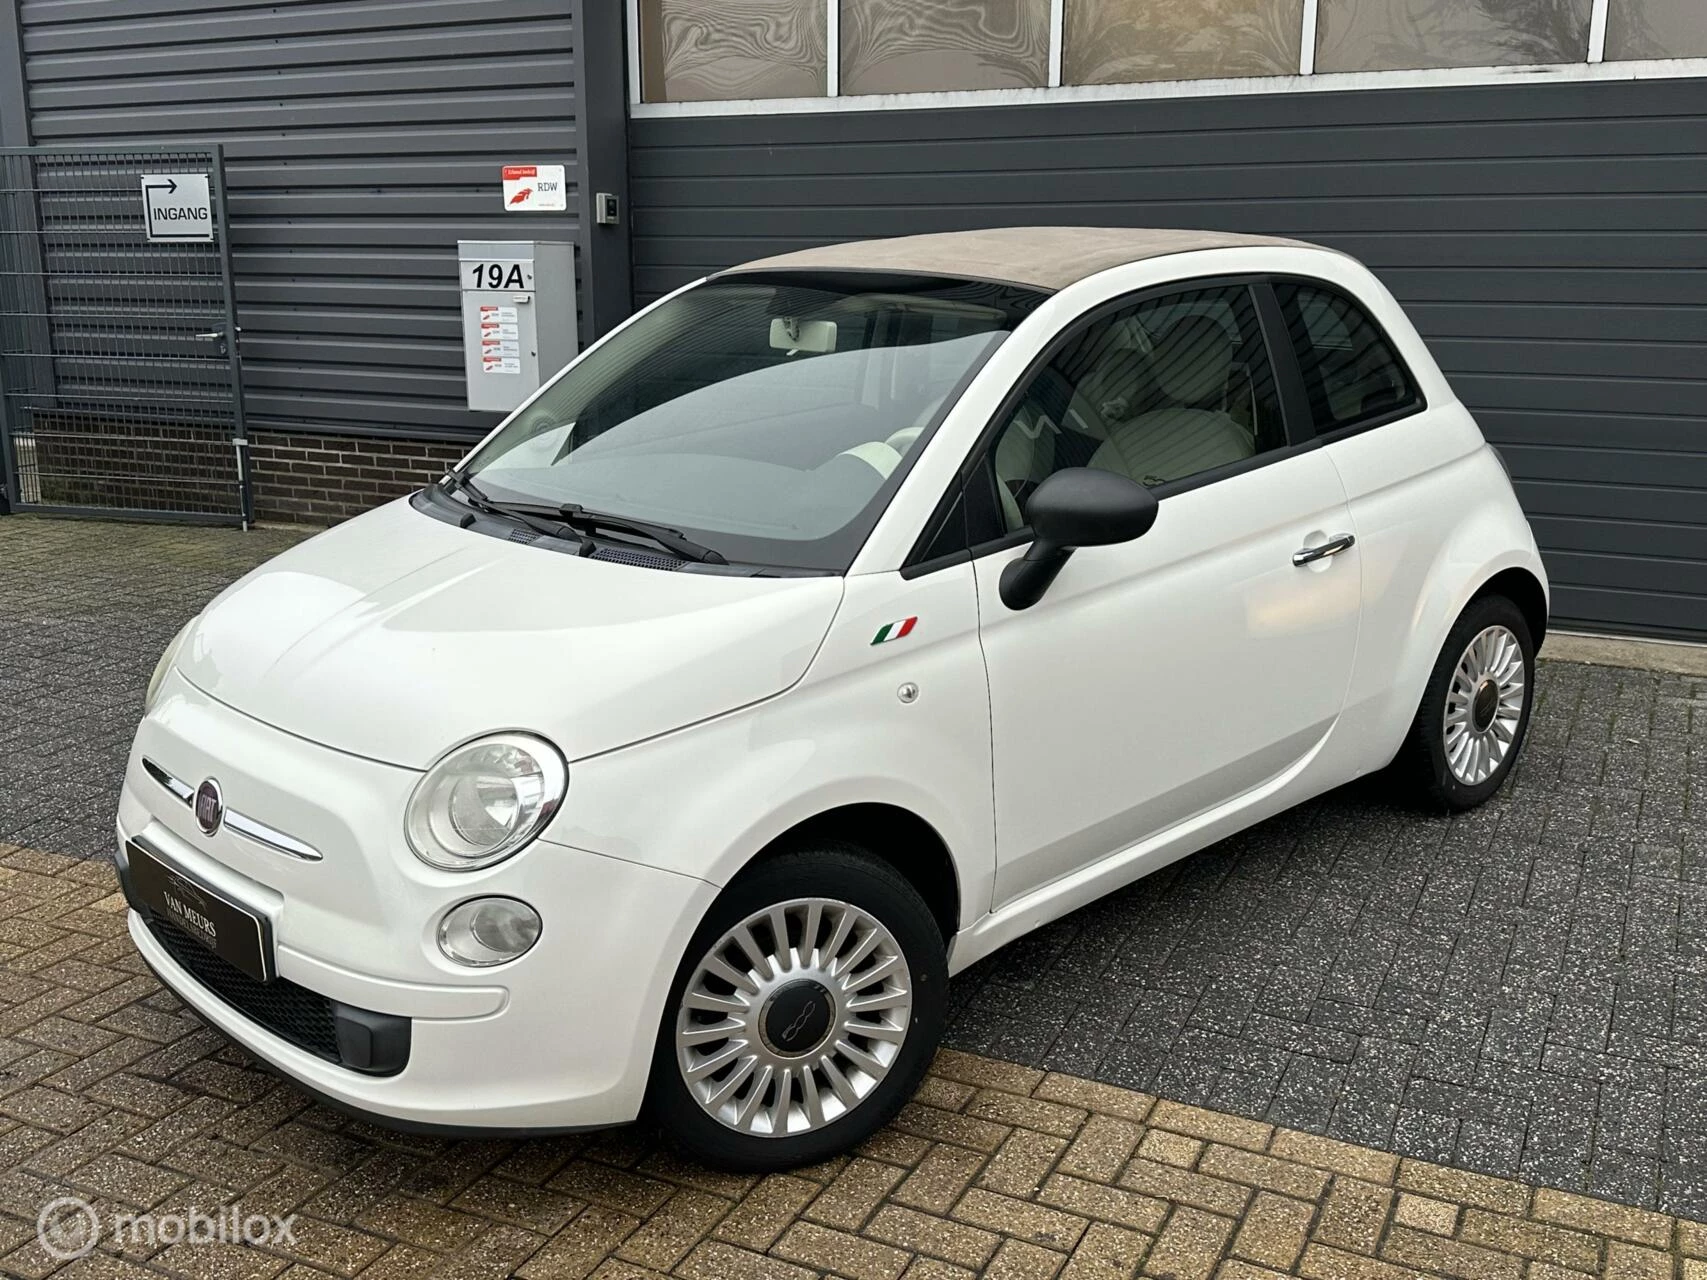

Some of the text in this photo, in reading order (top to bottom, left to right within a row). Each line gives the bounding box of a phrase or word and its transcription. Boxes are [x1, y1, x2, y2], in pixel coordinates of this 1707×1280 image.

[537, 182, 558, 192] RDW
[153, 207, 208, 220] INGANG
[472, 263, 525, 289] 19A
[198, 794, 217, 822] FIAT
[163, 891, 183, 914] VAN
[183, 904, 216, 937] MEURS
